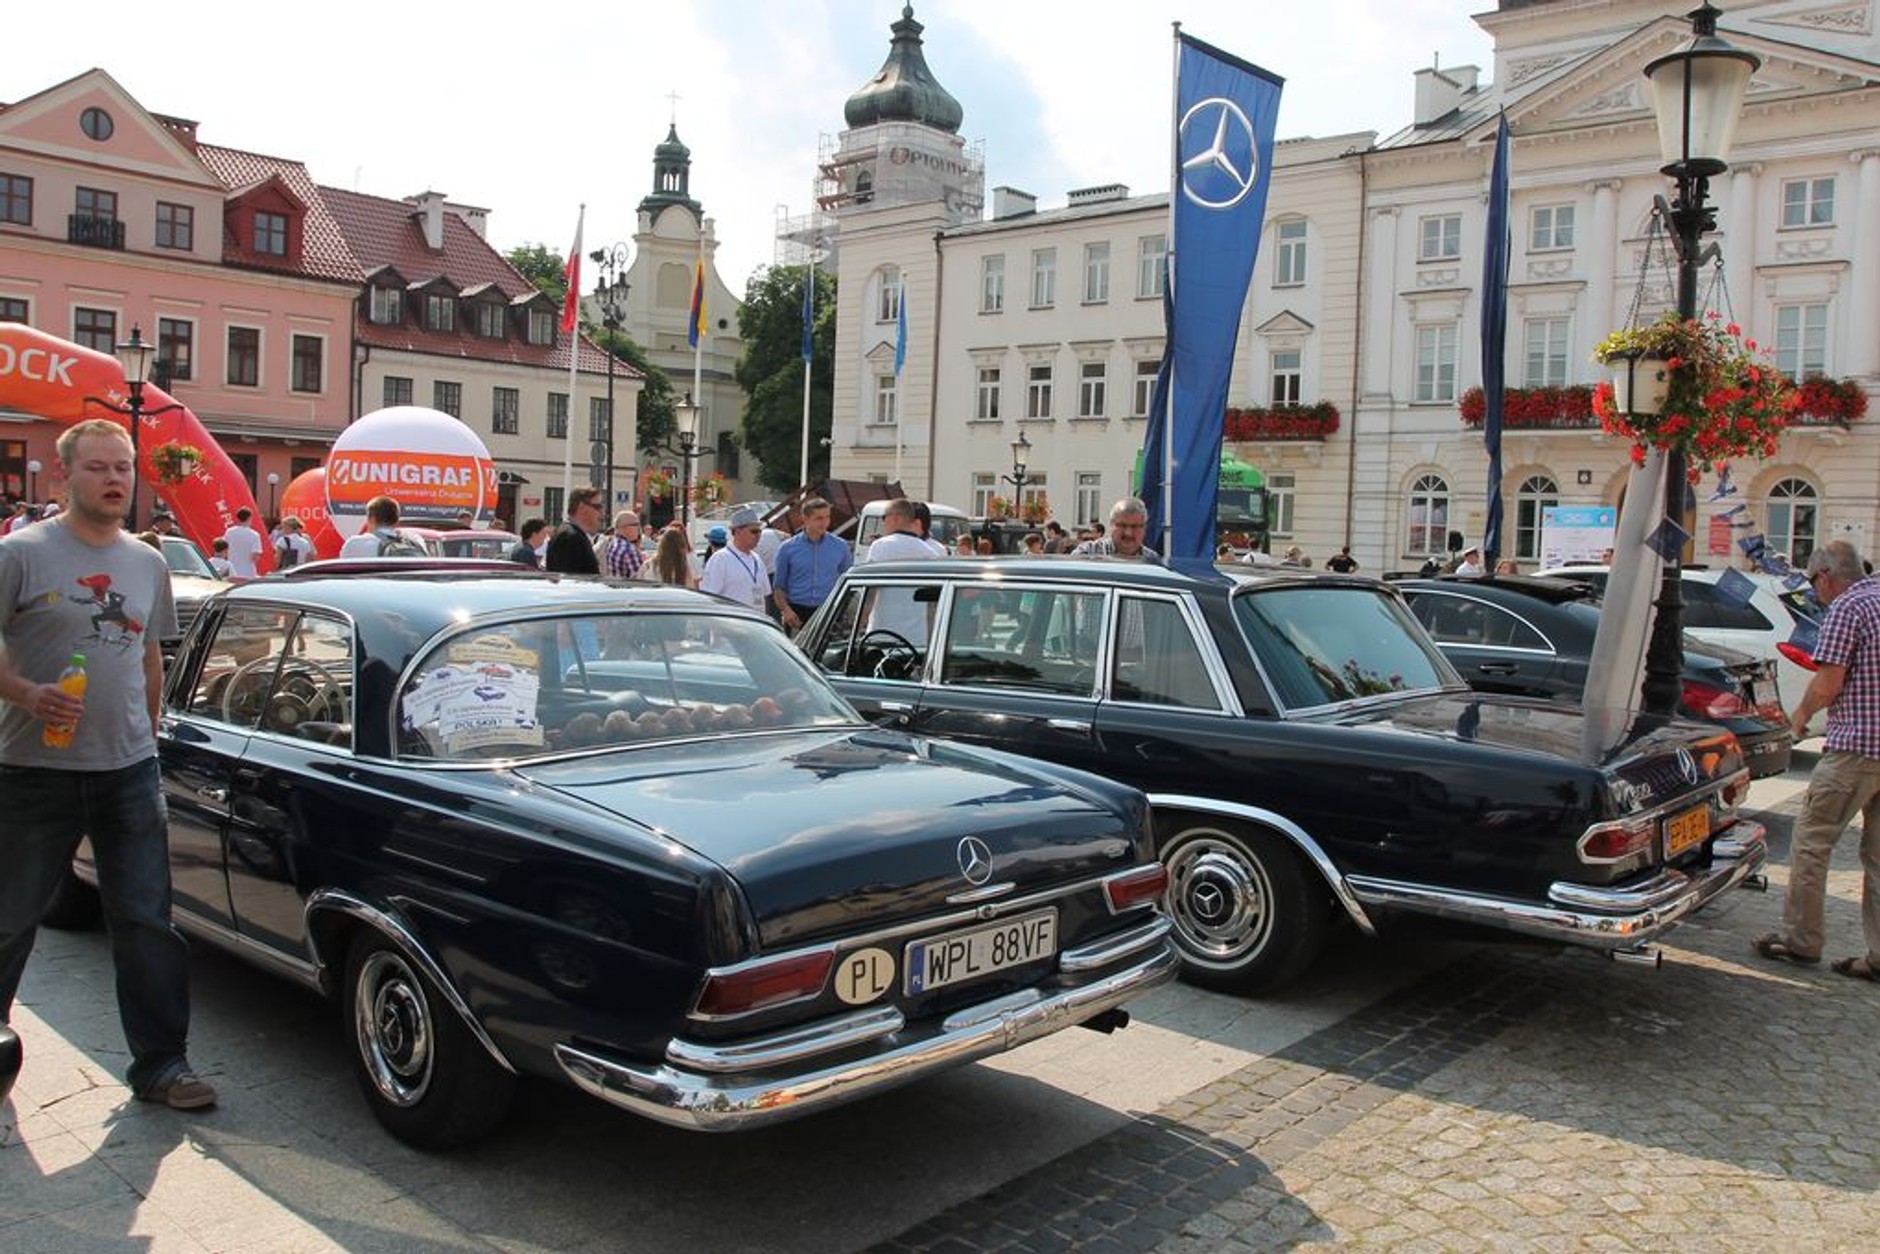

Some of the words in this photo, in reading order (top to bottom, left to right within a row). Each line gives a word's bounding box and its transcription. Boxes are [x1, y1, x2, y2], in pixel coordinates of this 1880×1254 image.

[351, 458, 472, 487] UNIGRAF
[928, 939, 980, 984] WPL
[990, 919, 1051, 966] 88VF
[851, 956, 884, 998] PL
